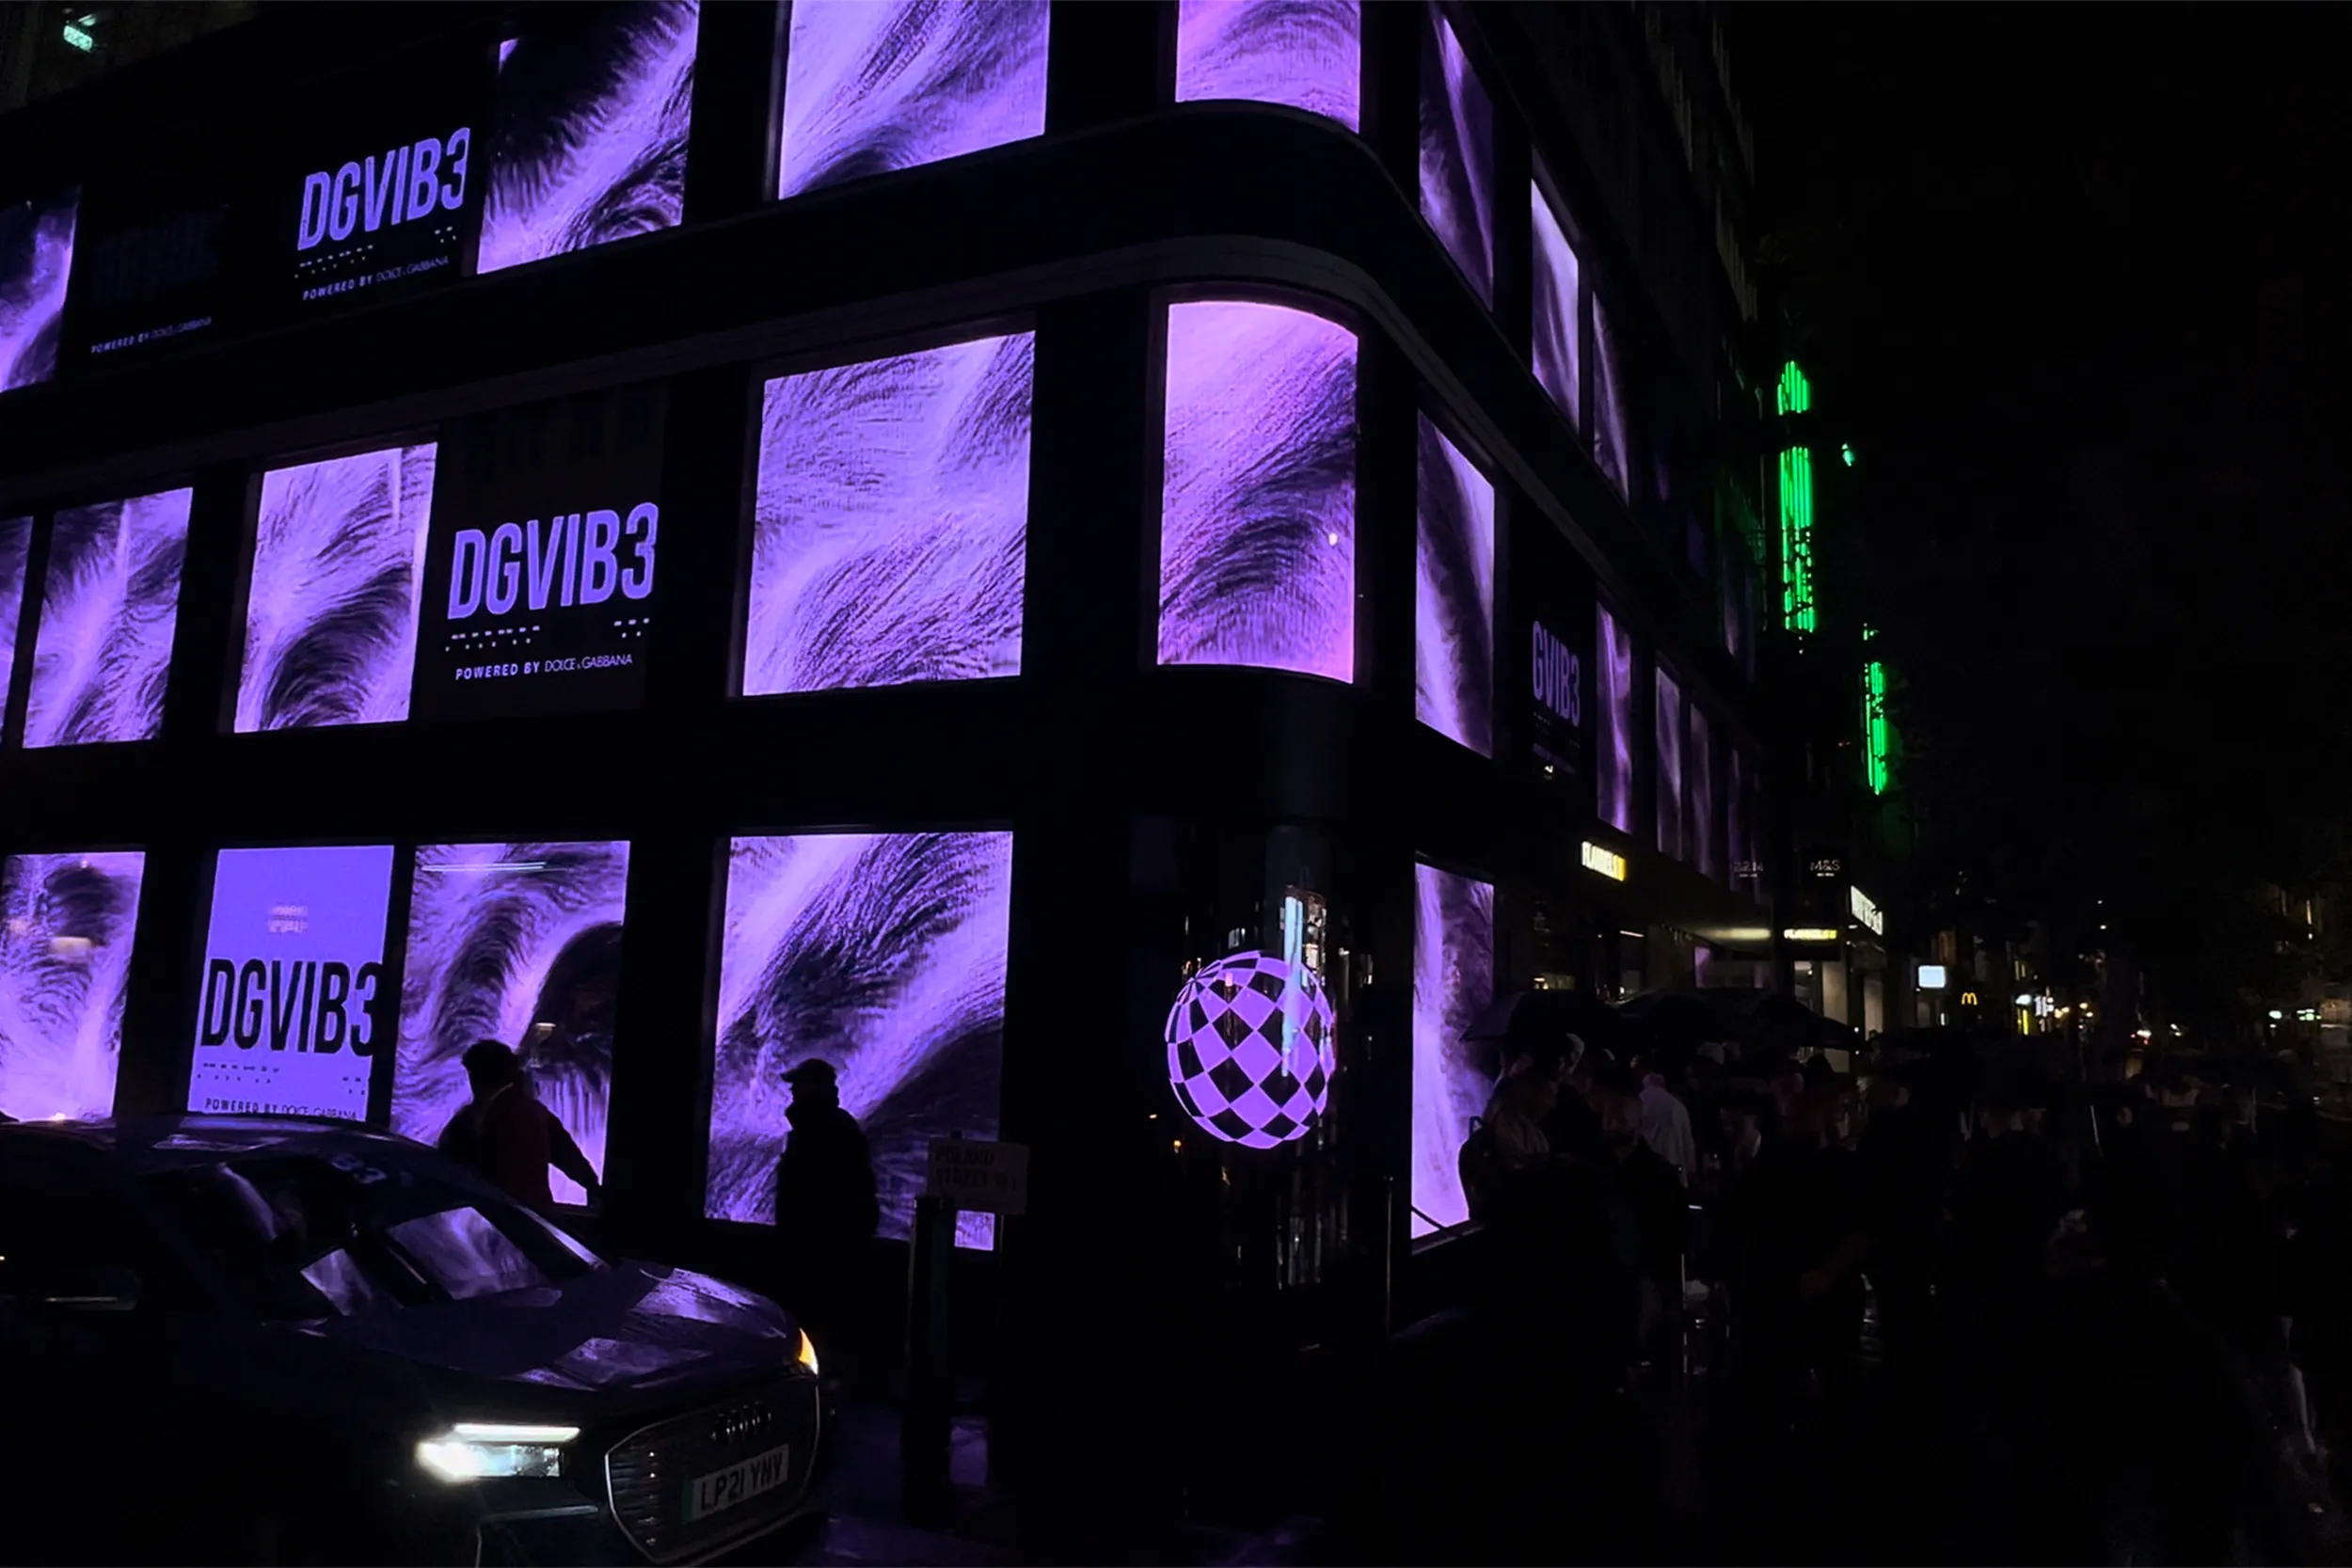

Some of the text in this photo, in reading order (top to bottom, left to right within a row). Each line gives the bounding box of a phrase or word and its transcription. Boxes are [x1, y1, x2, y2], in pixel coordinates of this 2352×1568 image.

[296, 126, 472, 252] DGVIB3
[302, 278, 355, 301] POWERED
[358, 275, 373, 287] BY
[446, 500, 660, 621] DGVIB3
[455, 663, 518, 681] POWERED
[523, 660, 541, 674] BY
[200, 958, 382, 1056] DGVIB3
[205, 1098, 259, 1115] POWERED
[701, 1466, 745, 1511] LP21
